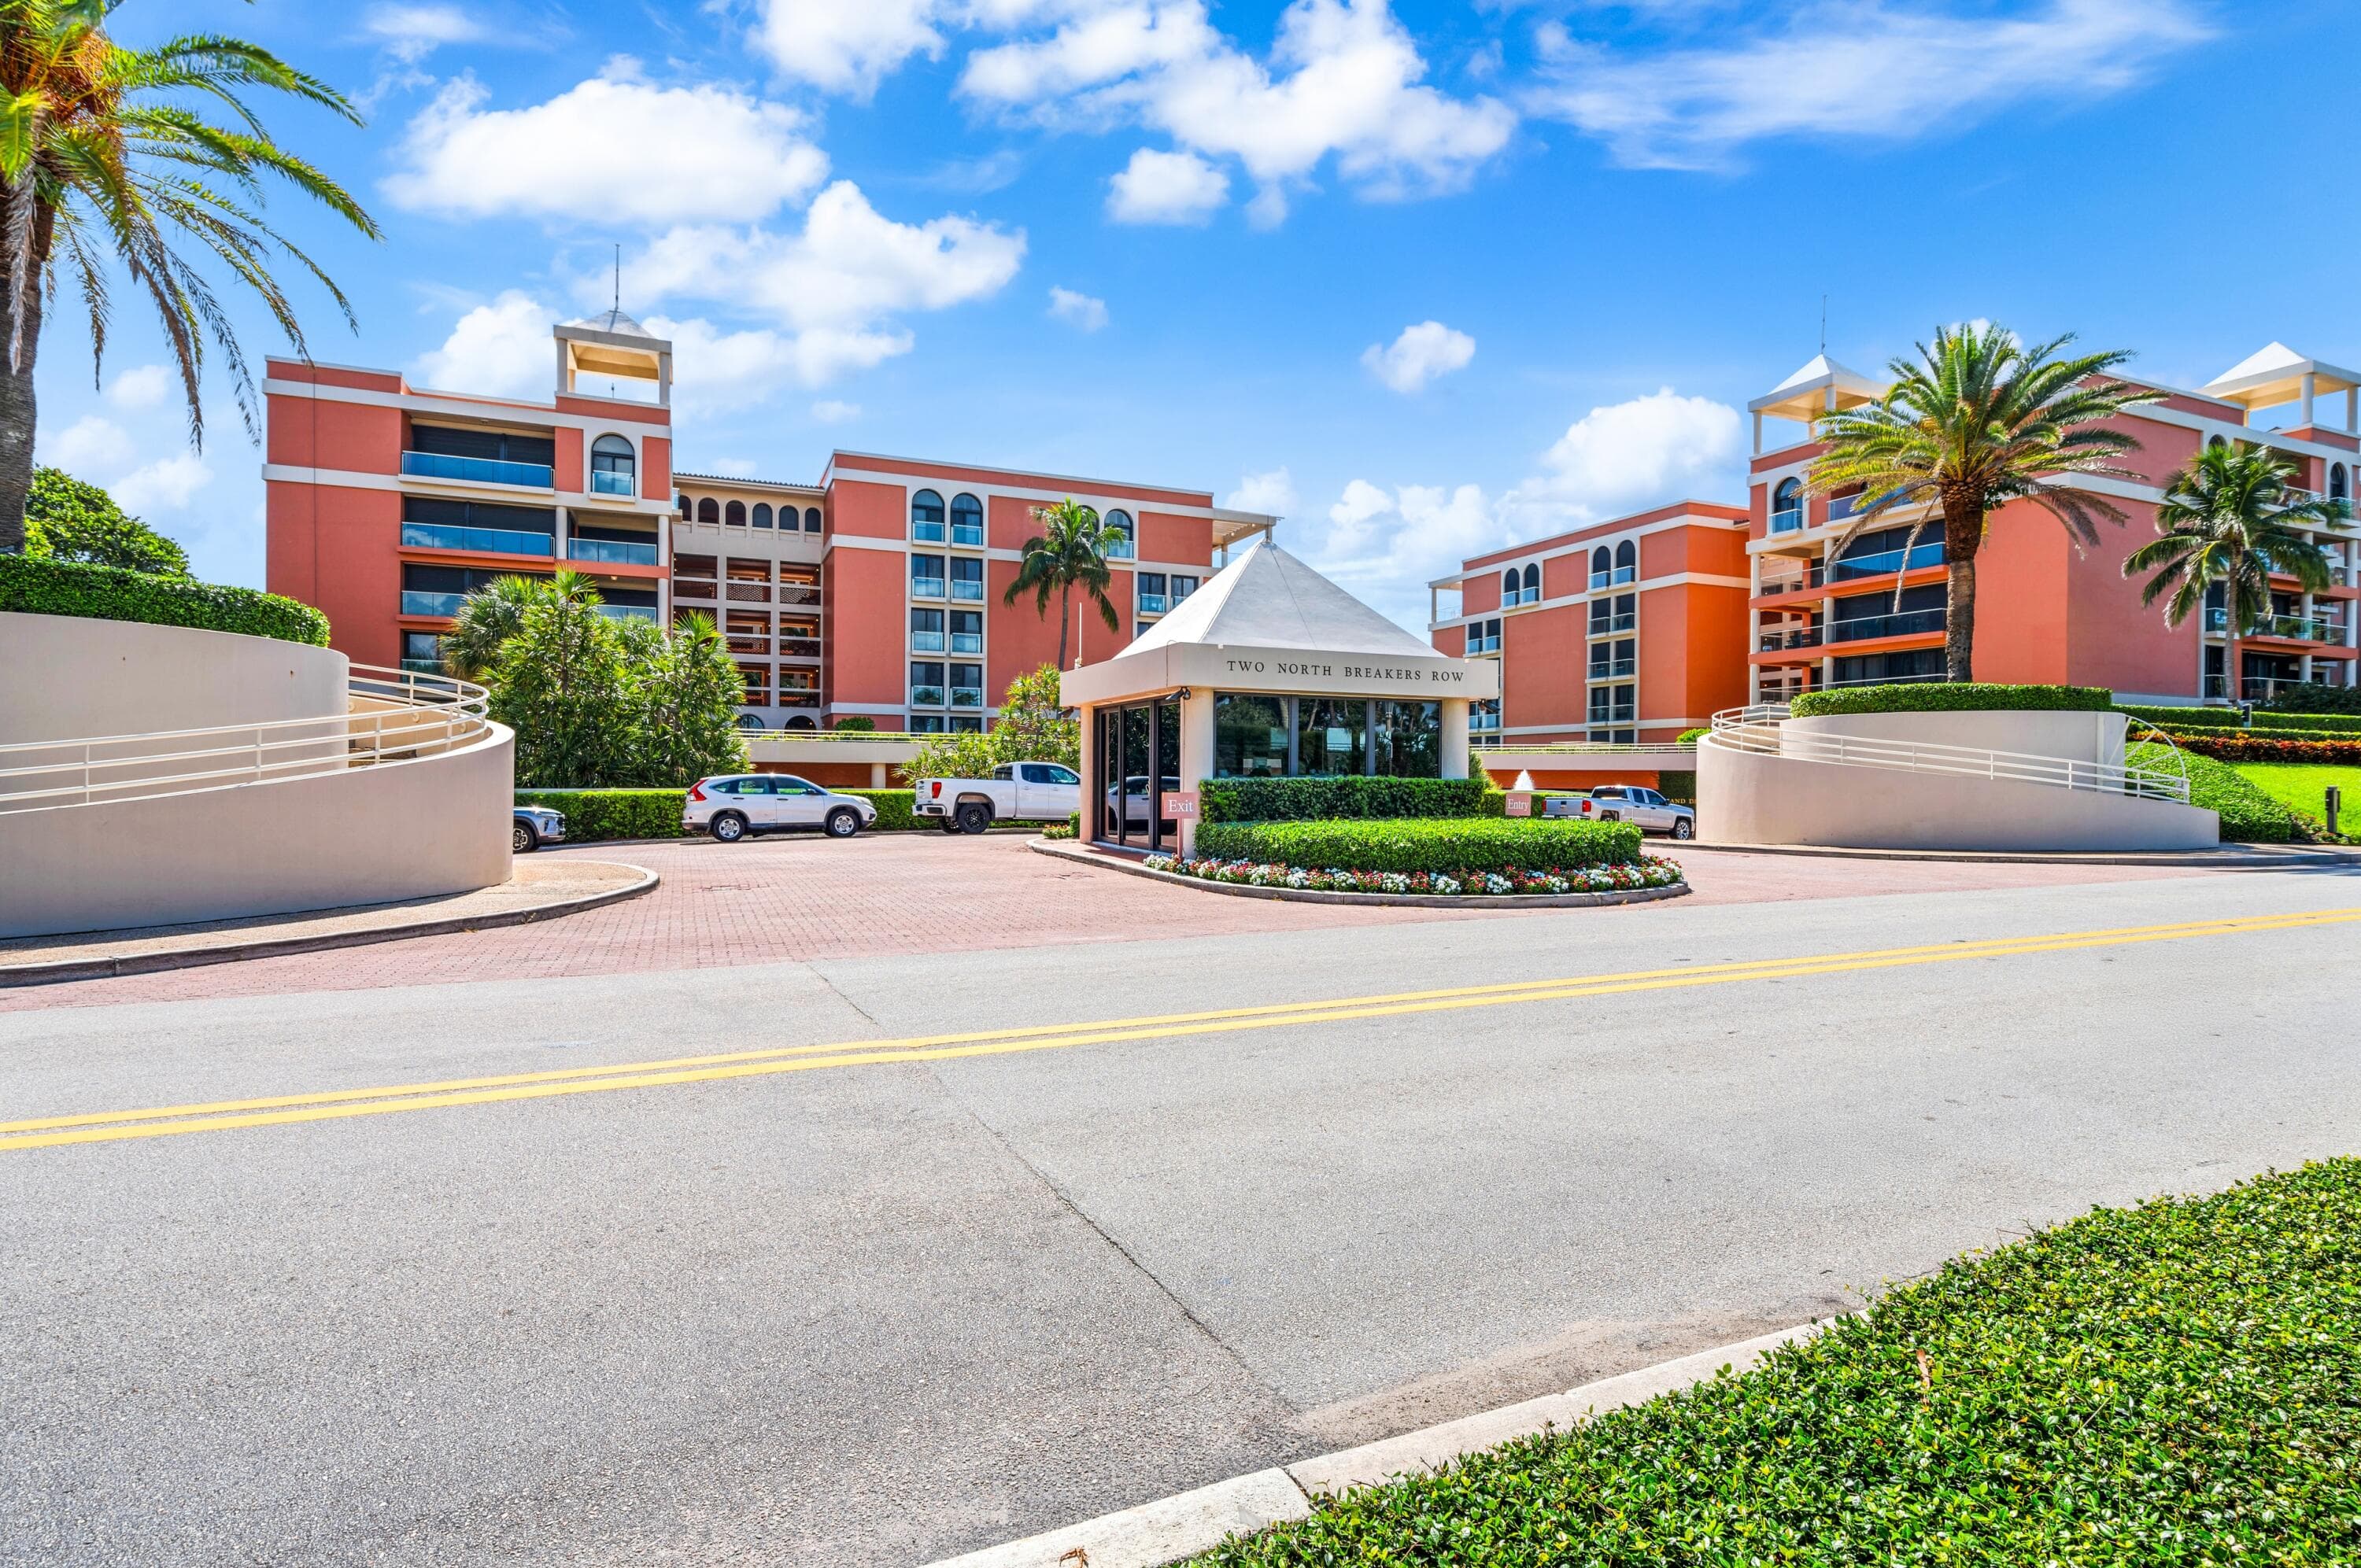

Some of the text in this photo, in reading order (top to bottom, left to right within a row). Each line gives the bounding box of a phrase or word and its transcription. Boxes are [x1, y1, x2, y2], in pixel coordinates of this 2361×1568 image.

[1227, 660, 1464, 682] TWO NORTH BREAKERS ROW
[1169, 799, 1193, 812] Exit
[1508, 799, 1529, 812] Entry
